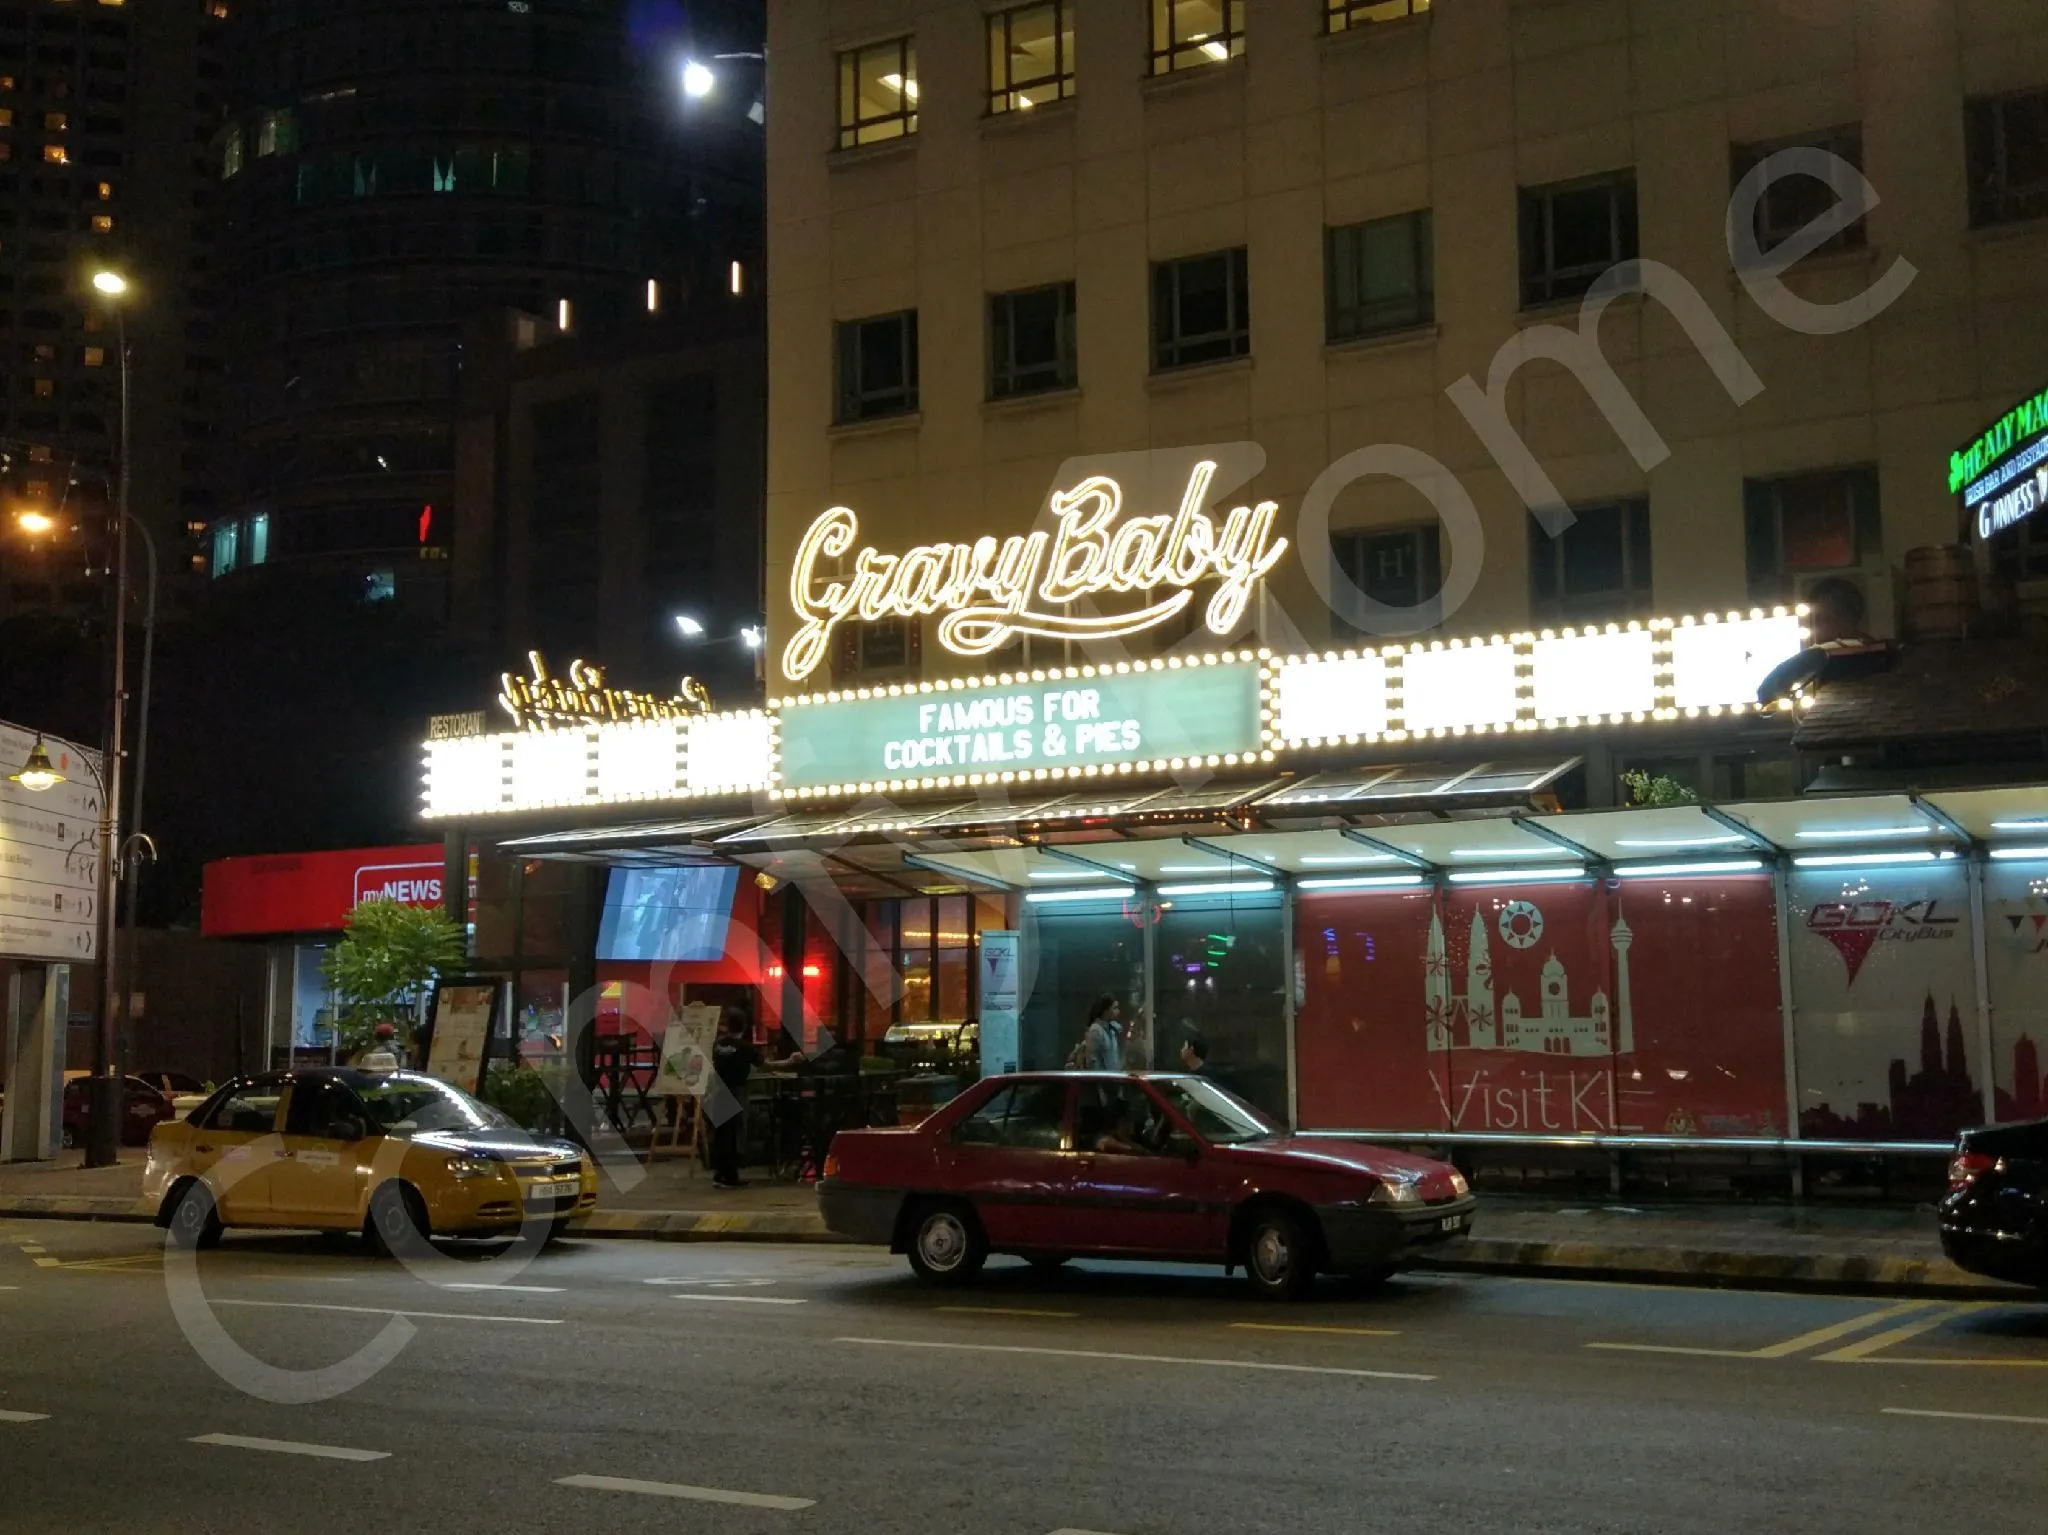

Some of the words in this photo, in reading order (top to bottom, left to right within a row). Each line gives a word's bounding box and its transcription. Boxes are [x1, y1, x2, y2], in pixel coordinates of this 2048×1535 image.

[1963, 411, 2016, 485] HEALY
[2001, 457, 2016, 484] AND
[782, 506, 1050, 681] Gravy
[1040, 460, 1288, 634] Baby
[430, 713, 480, 738] RESTORAN
[919, 695, 1034, 733] FAMOUS
[1043, 689, 1100, 722] FOR
[884, 729, 1033, 770] COCKTAILS
[1042, 723, 1067, 757] &
[1075, 719, 1141, 754] PIES
[1428, 1069, 1560, 1128] Visit
[1570, 1070, 1644, 1131] KL
